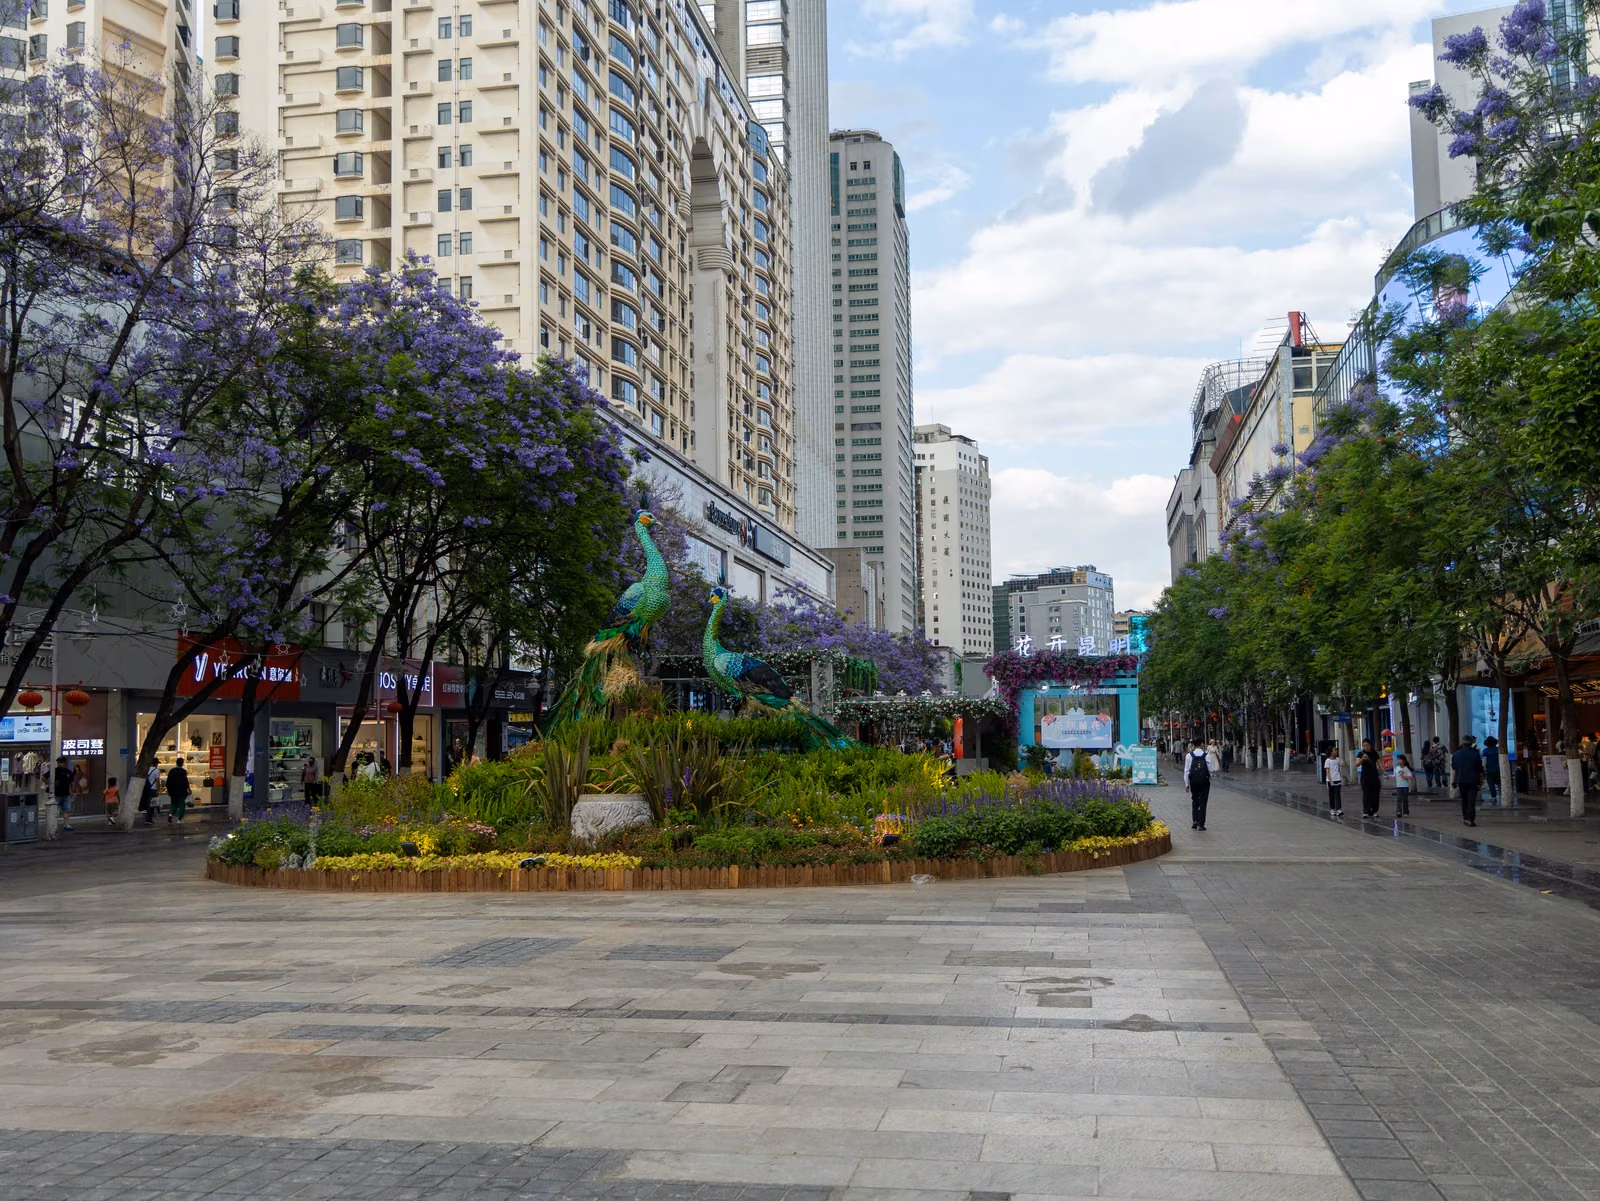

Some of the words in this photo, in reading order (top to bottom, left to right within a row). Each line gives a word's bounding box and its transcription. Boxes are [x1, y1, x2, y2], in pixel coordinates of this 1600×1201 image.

[1014, 634, 1131, 656] 花开昆明
[62, 739, 104, 750] 波司登
